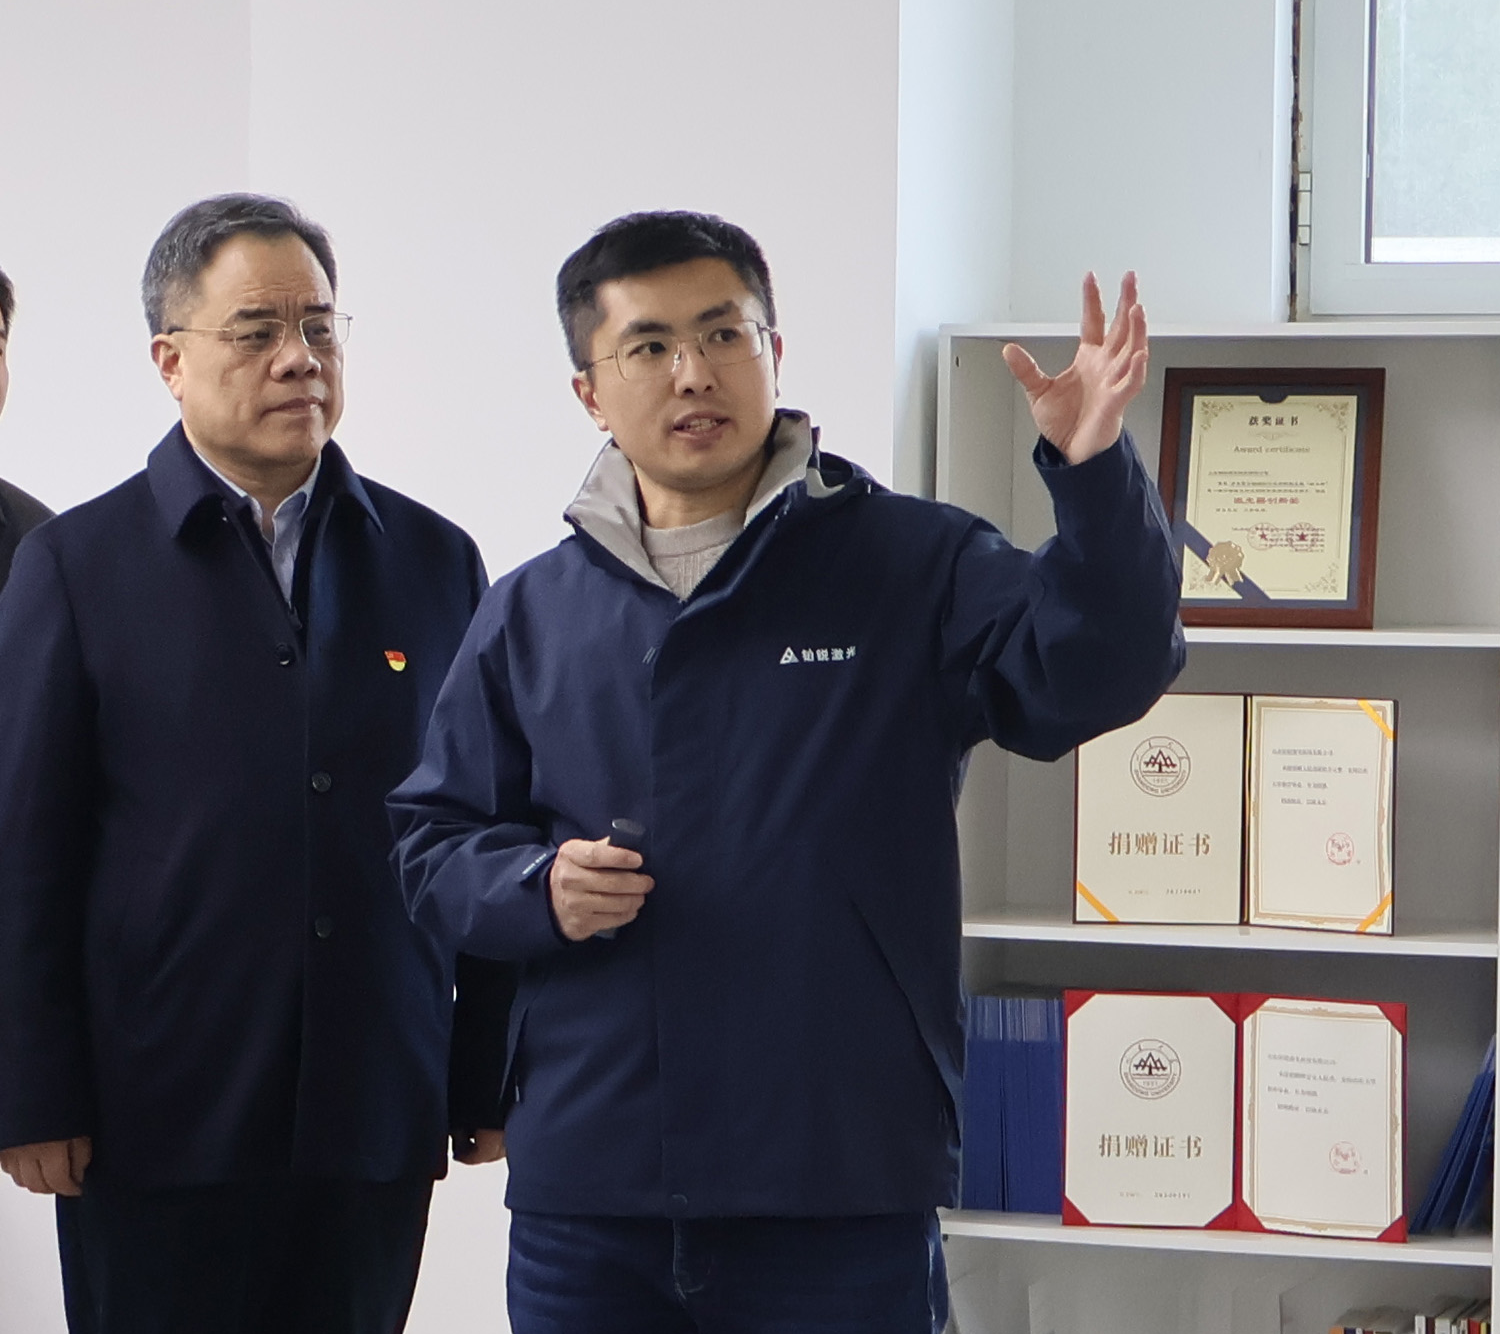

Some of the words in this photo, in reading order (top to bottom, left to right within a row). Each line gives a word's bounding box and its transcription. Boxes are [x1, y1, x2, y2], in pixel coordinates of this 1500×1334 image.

[1108, 832, 1211, 856] 捐赠证书
[1099, 1134, 1203, 1159] 捐赠证书
